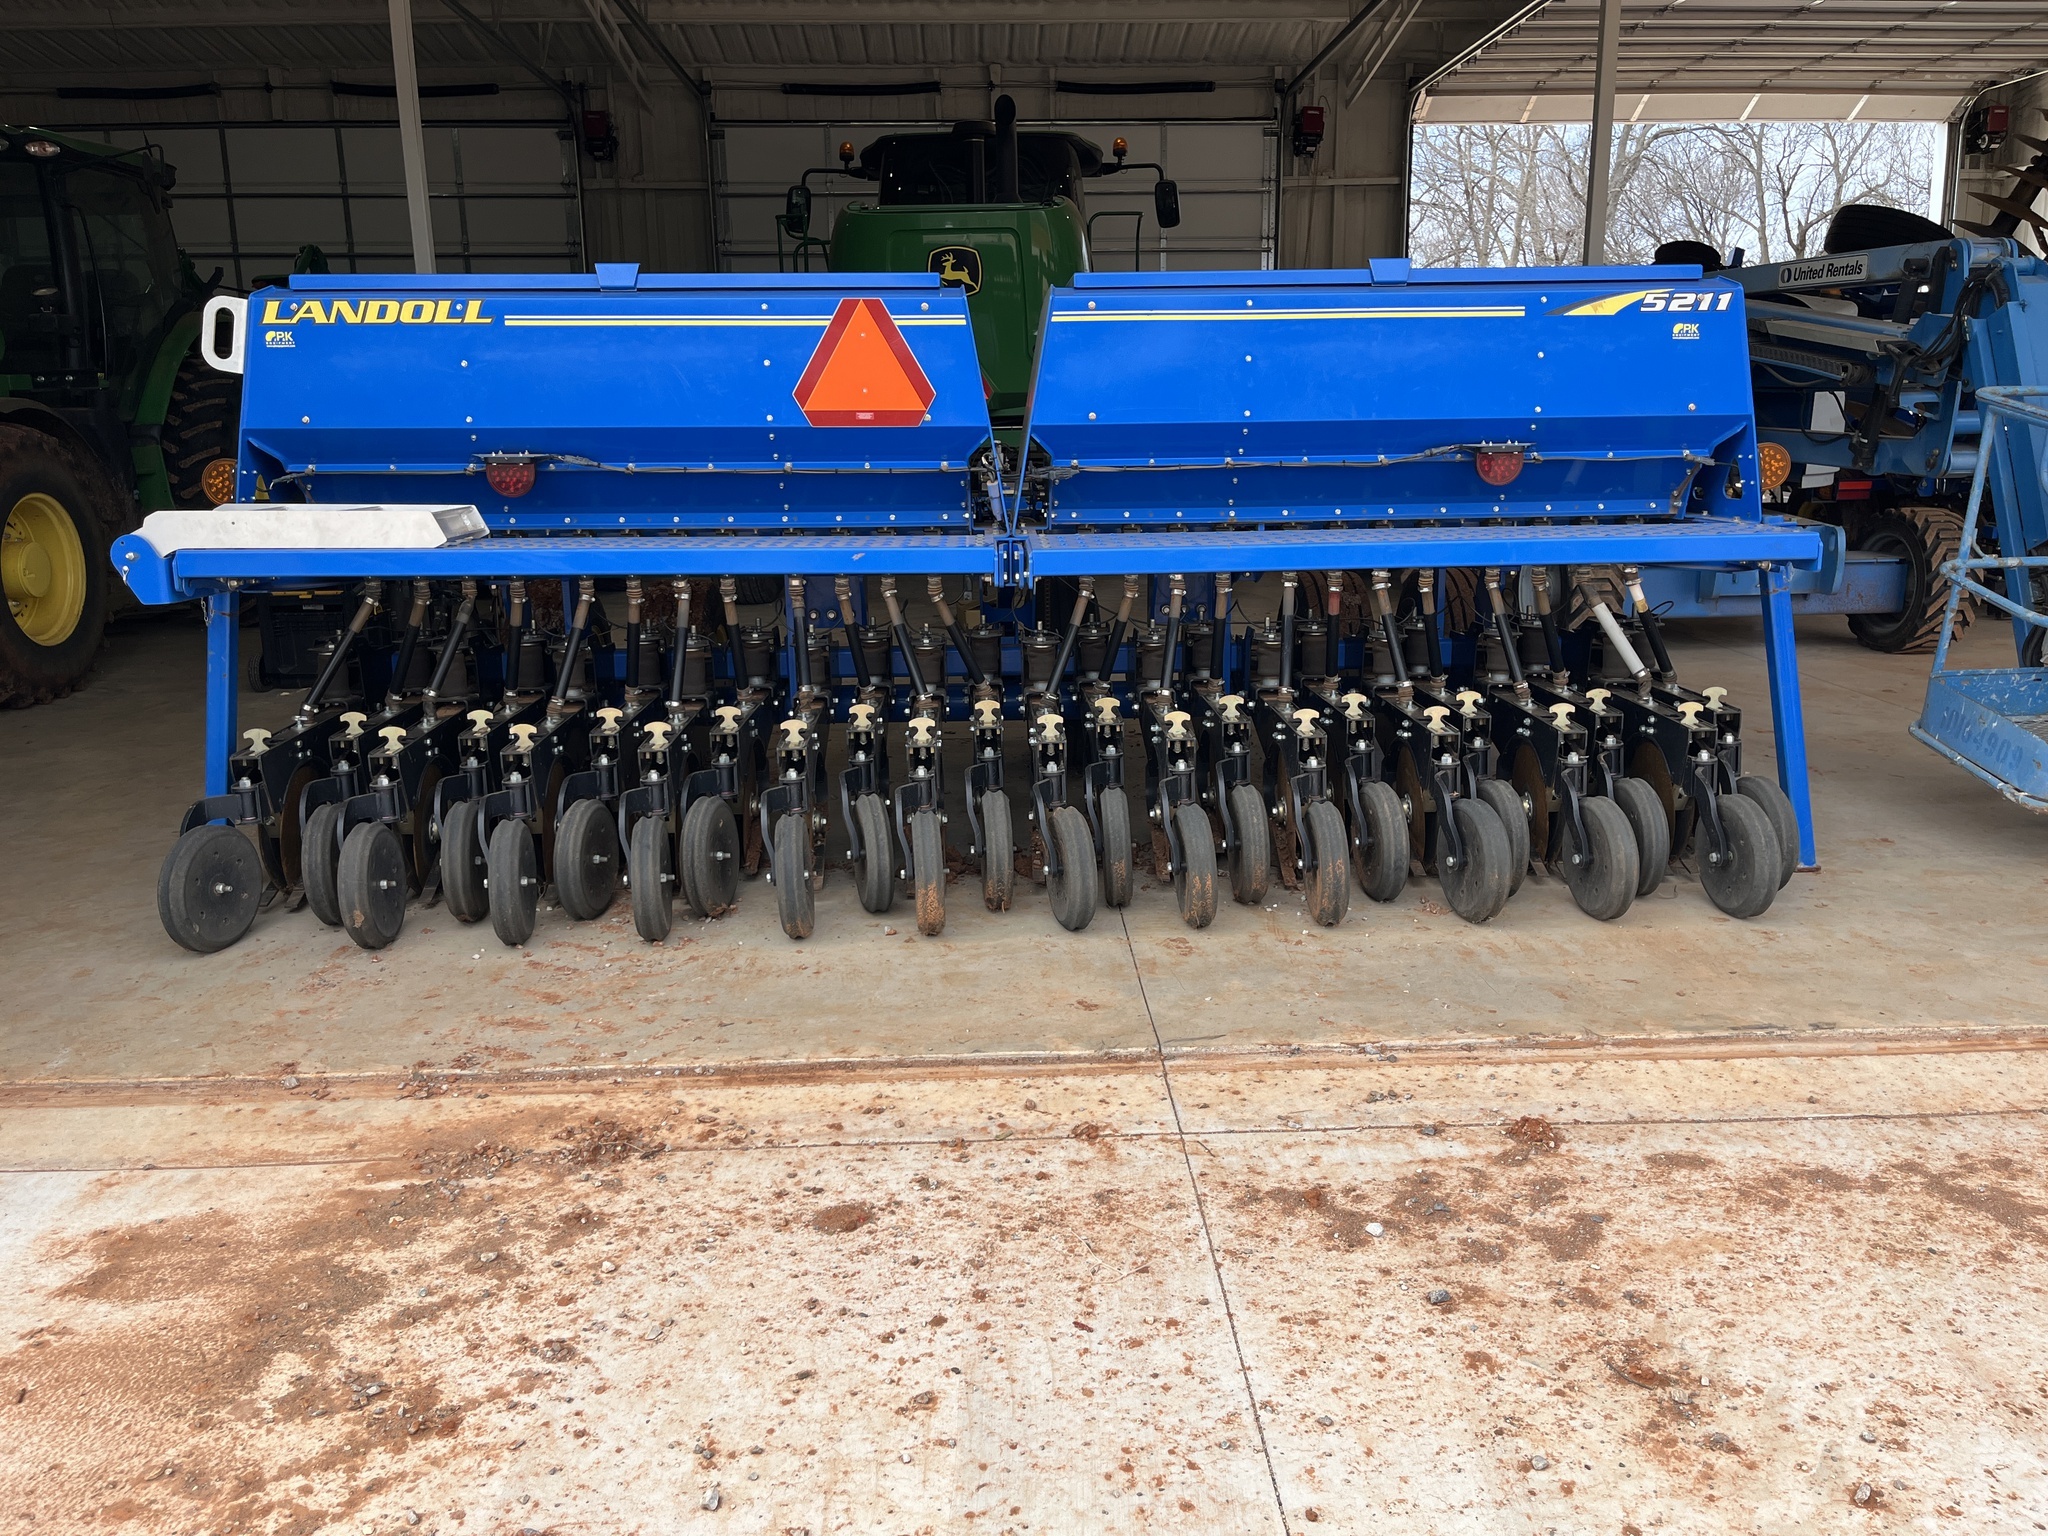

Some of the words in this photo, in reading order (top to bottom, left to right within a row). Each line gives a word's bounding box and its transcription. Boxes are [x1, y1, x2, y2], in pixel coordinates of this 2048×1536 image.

[1793, 264, 1825, 282] United
[1826, 260, 1863, 278] Rentals
[260, 299, 494, 325] LANDOLL
[1640, 291, 1733, 312] 5211
